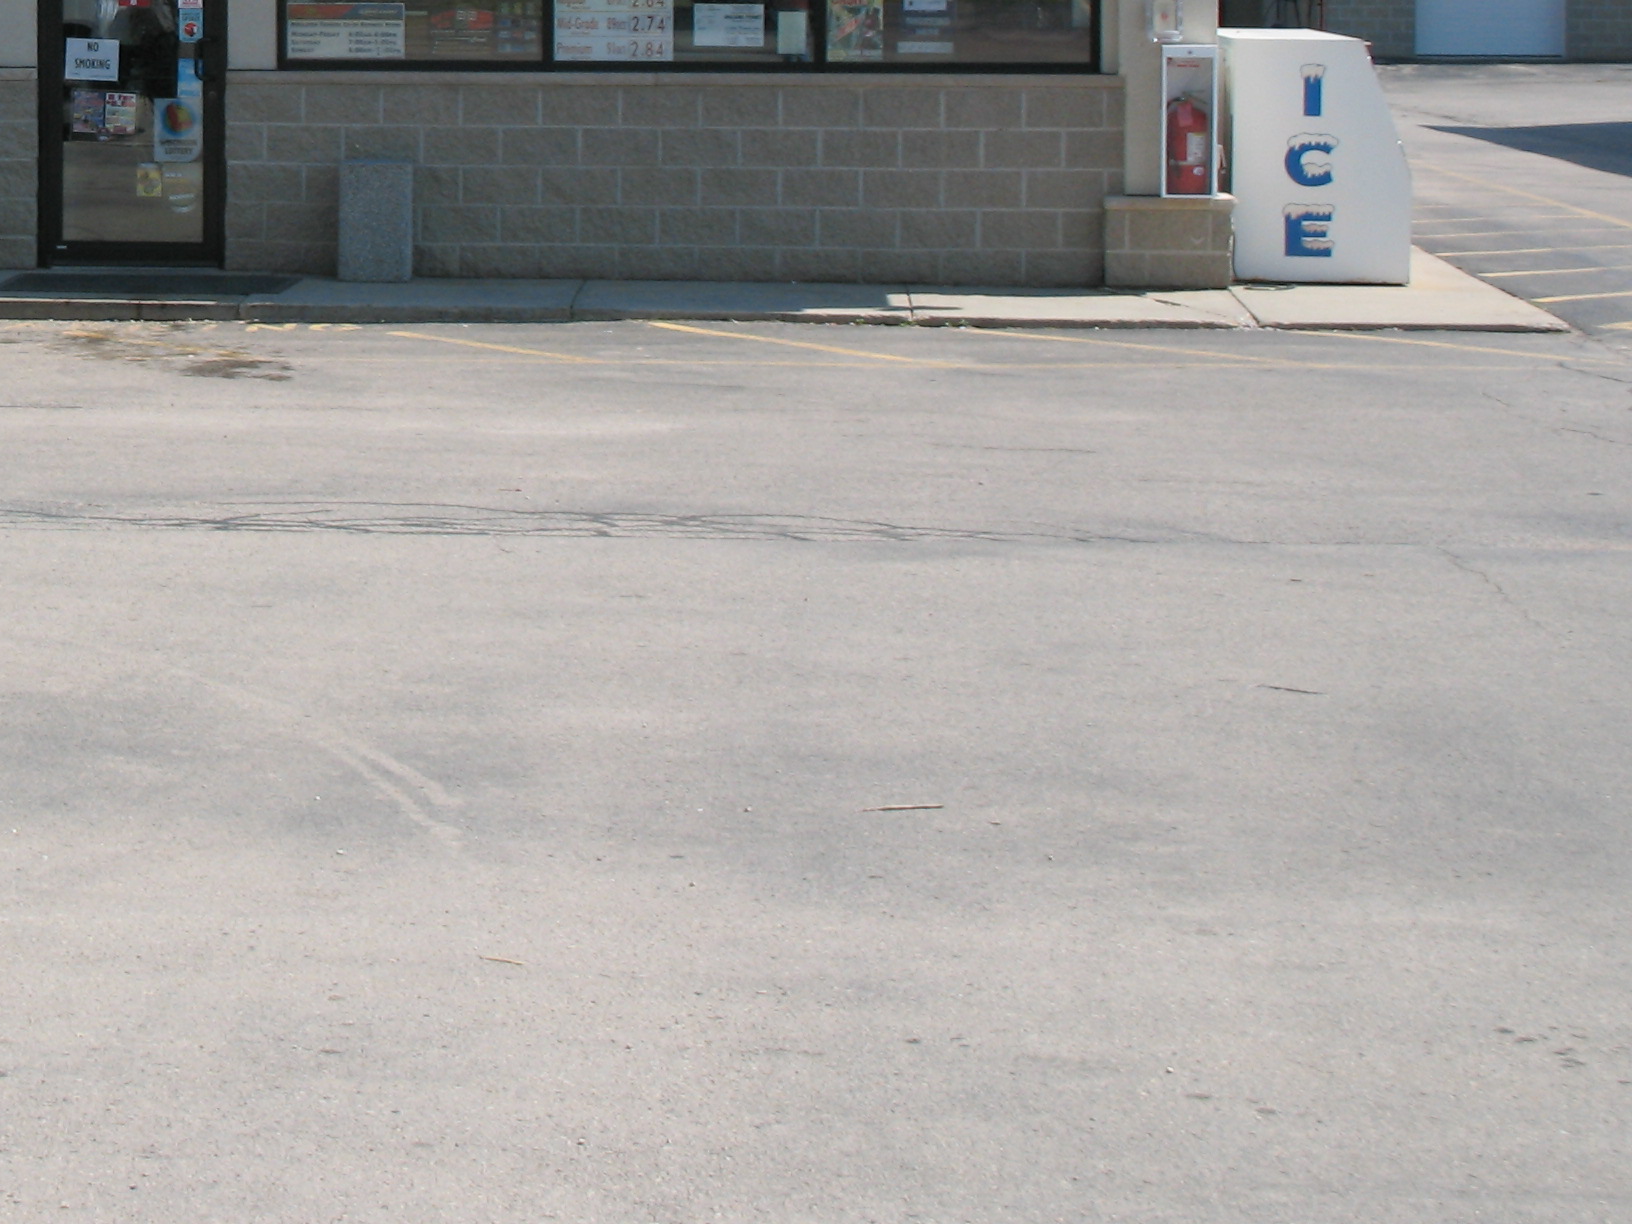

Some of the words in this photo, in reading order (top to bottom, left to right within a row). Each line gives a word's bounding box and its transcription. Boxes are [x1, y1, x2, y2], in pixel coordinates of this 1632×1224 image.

[631, 15, 666, 32] 2.74
[87, 41, 99, 52] NO
[630, 41, 664, 57] 2.84
[74, 57, 111, 70] SMOKING
[1282, 63, 1339, 257] ICE
